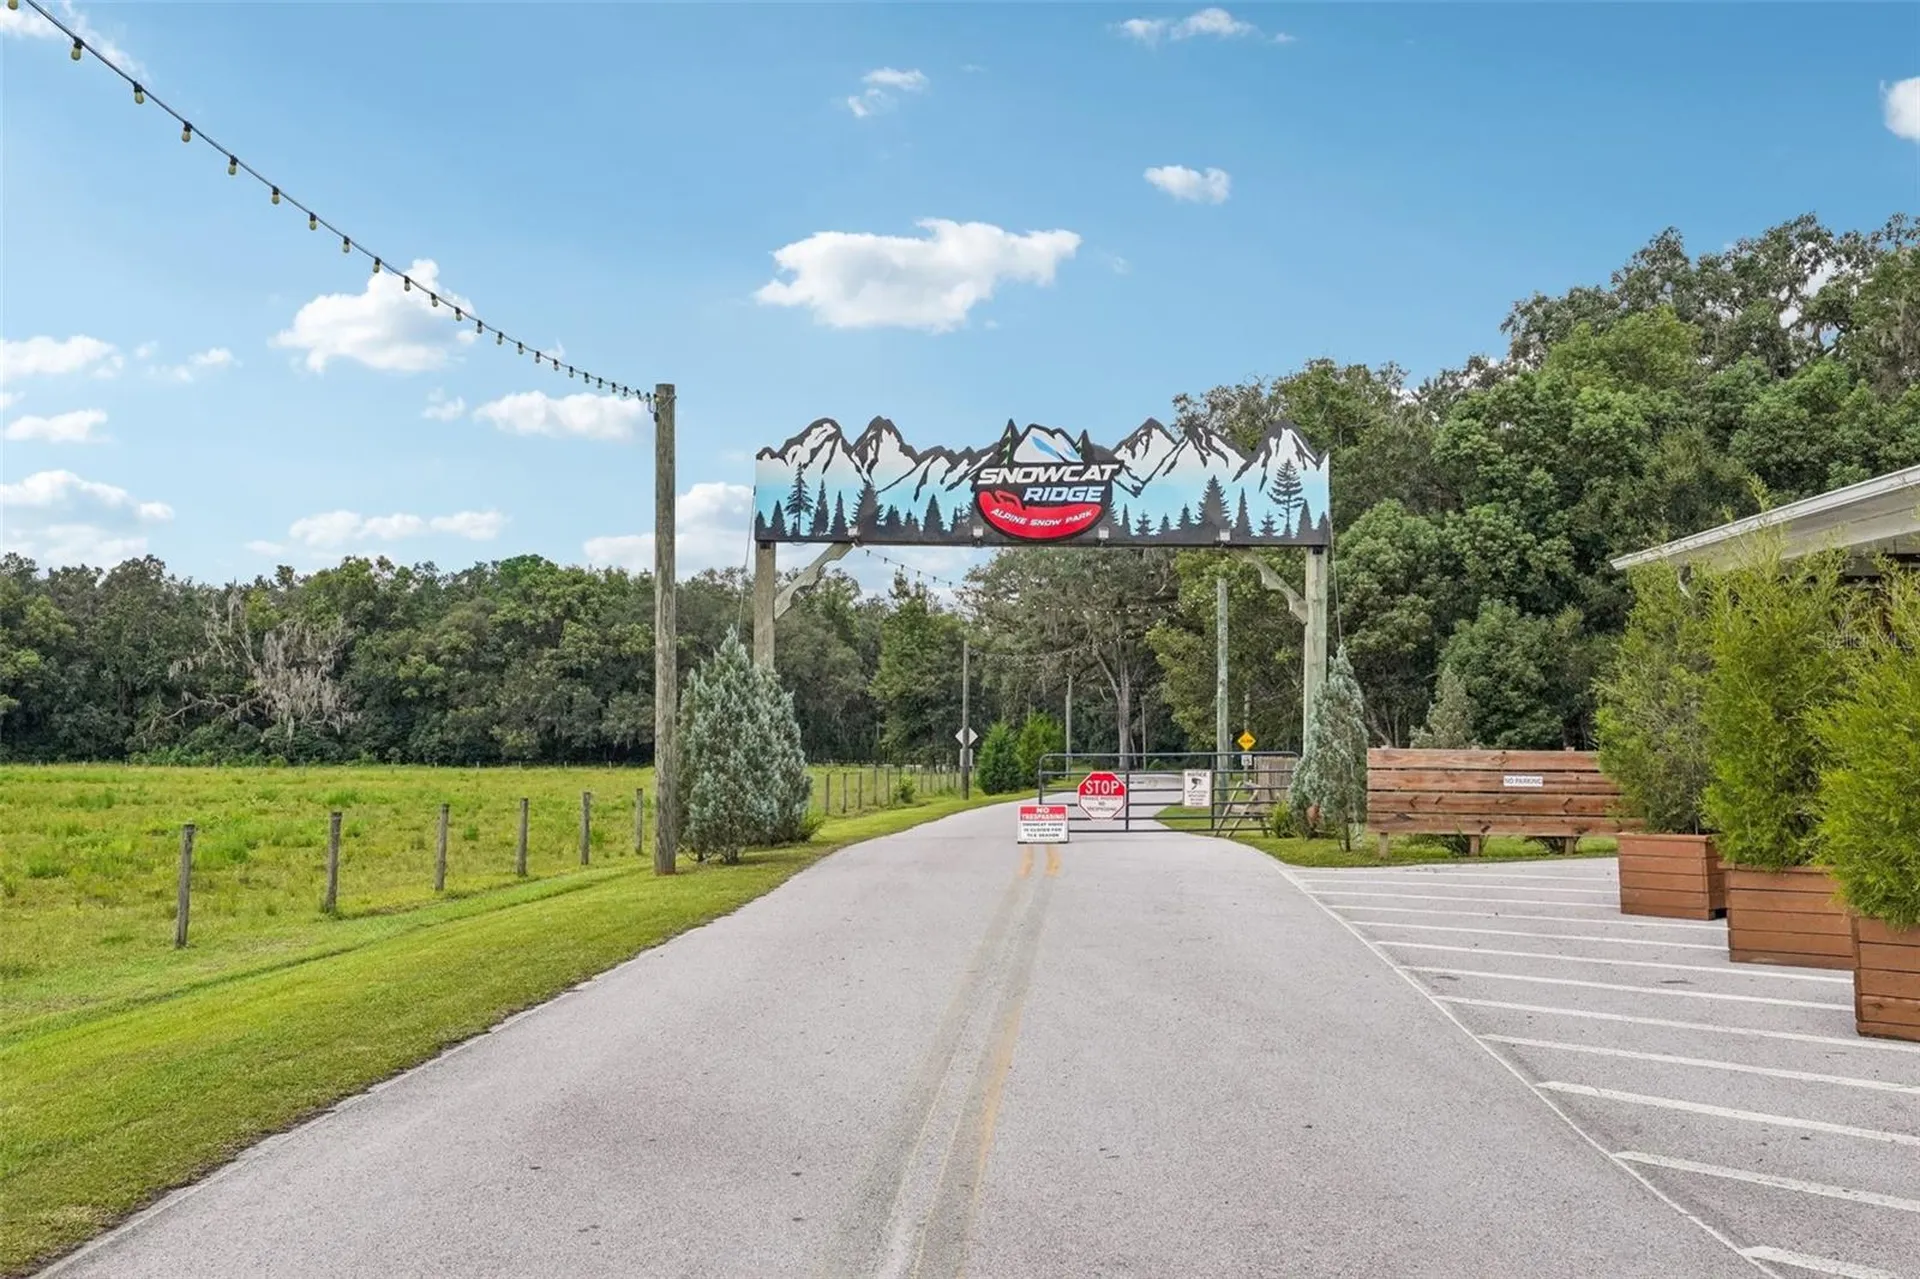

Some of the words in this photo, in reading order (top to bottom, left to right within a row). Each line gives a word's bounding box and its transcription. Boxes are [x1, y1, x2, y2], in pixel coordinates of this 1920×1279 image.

[977, 464, 1120, 485] SNOWCAT
[1023, 486, 1105, 502] RIDGE
[990, 508, 1027, 525] ALPINE
[1029, 517, 1062, 526] SNOW
[1064, 509, 1093, 524] PARK
[1085, 780, 1120, 795] STOP
[1515, 777, 1542, 785] PARKING
[1036, 806, 1050, 814] NO
